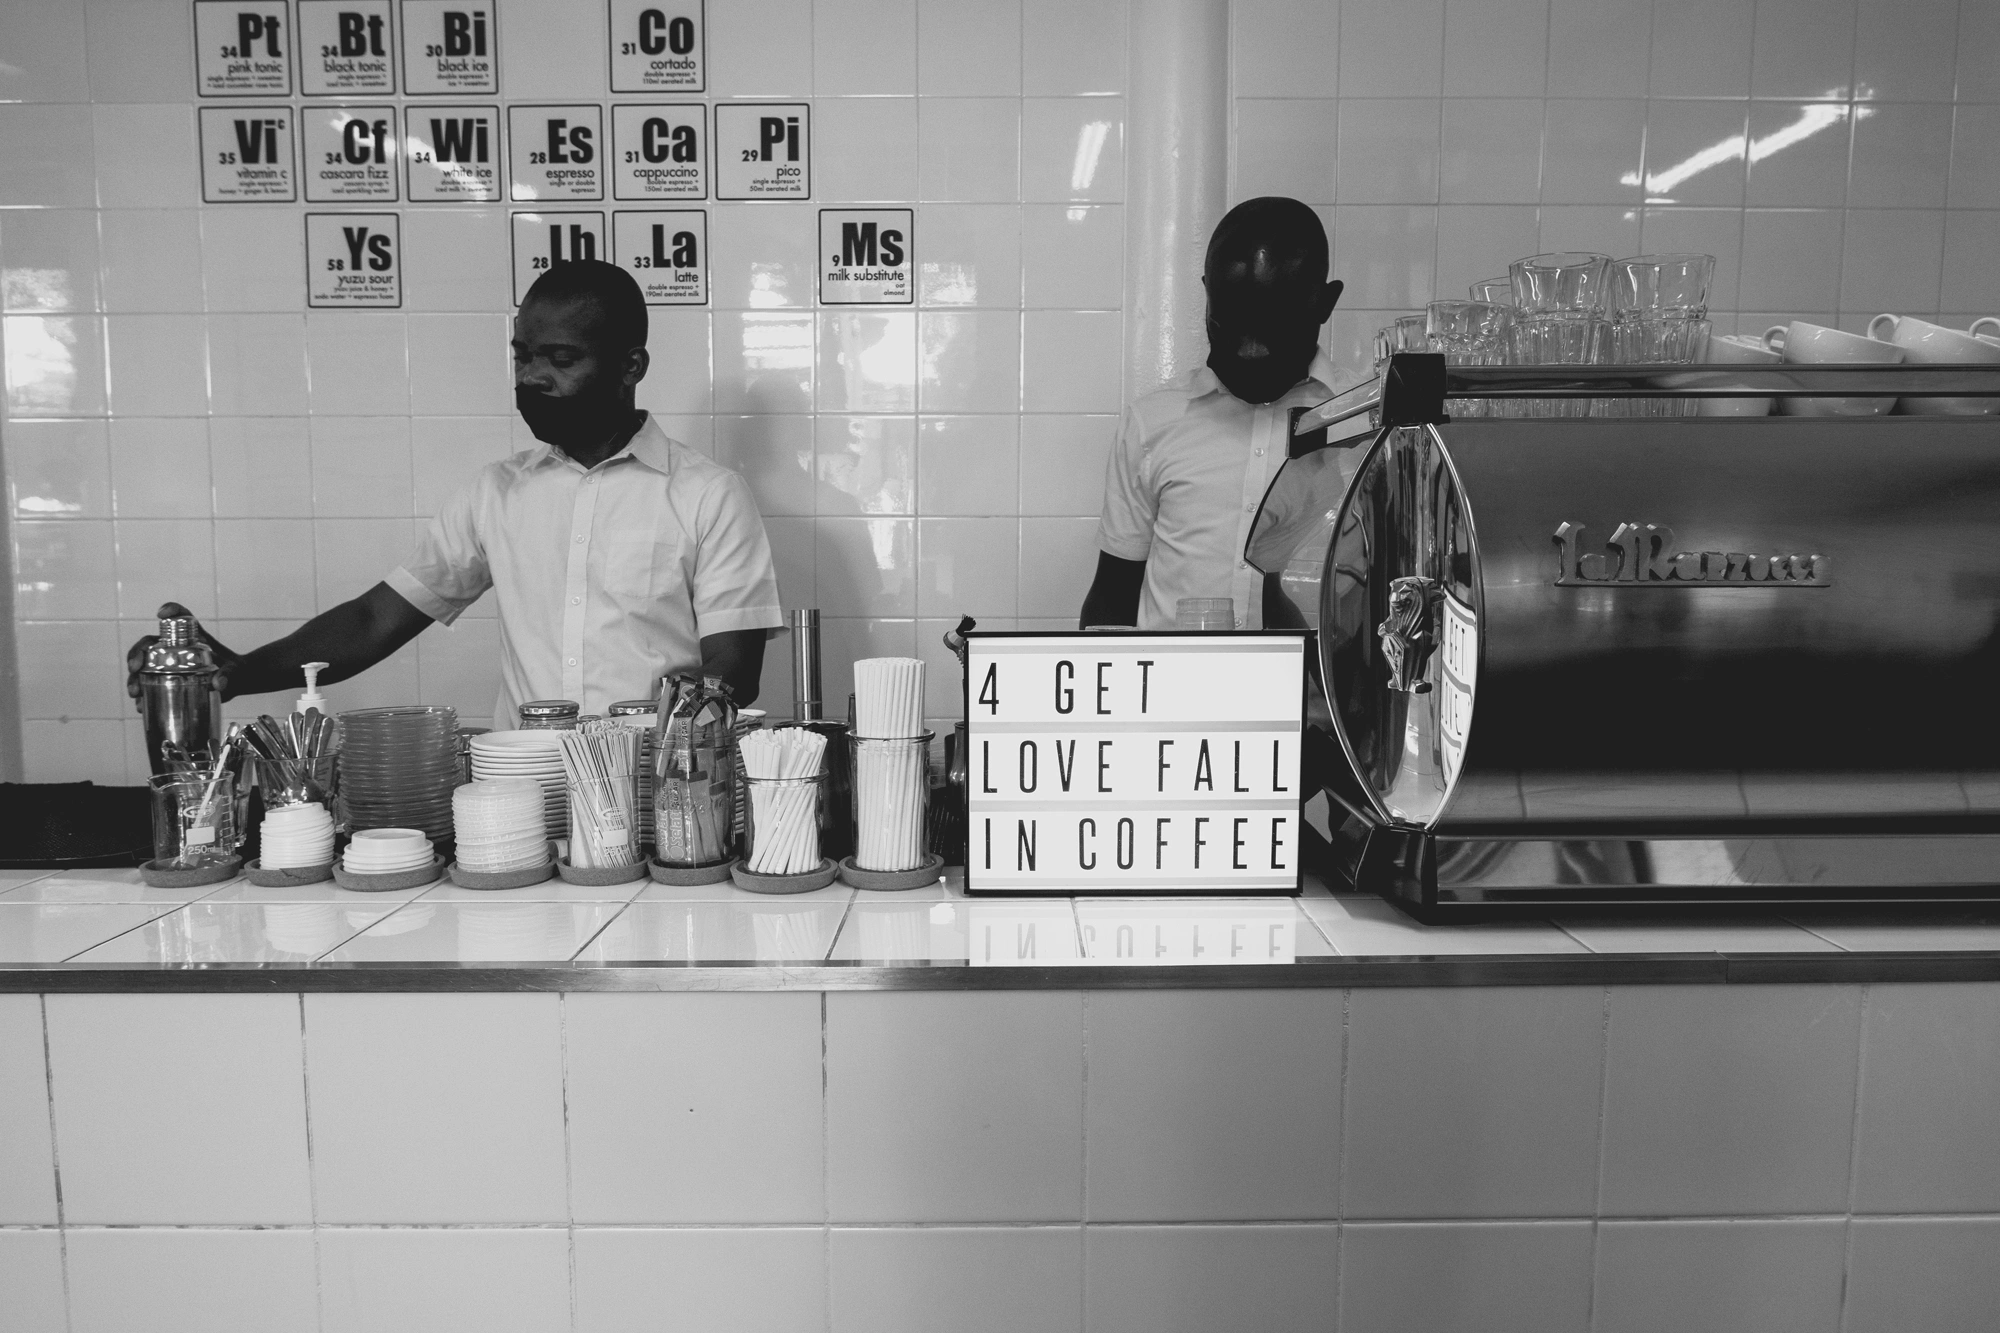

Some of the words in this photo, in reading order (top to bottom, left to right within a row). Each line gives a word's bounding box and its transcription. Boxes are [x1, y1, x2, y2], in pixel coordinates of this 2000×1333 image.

[221, 46, 238, 58] 34
[238, 13, 282, 57] Pt
[321, 45, 338, 57] 34
[339, 12, 386, 57] Bt
[426, 45, 442, 57] 30
[444, 11, 486, 57] Bi
[622, 43, 636, 55] 31
[639, 9, 694, 55] Co
[228, 60, 252, 76] pink
[255, 61, 282, 73] tonic
[324, 59, 356, 72] black
[358, 60, 386, 72] tonic
[437, 58, 469, 72] black
[472, 59, 489, 72] ice
[650, 56, 696, 70] cortado
[219, 152, 235, 165] 35
[326, 152, 342, 165] 34
[344, 119, 387, 165] Cf
[415, 152, 430, 163] 34
[430, 118, 489, 163] Wi
[530, 152, 547, 164] 28
[547, 119, 594, 164] Es
[625, 151, 639, 163] 31
[641, 117, 697, 163] Ca
[742, 149, 758, 162] 29
[760, 117, 799, 162] Pi
[237, 167, 277, 179] vitamin
[320, 170, 365, 179] cascara
[367, 165, 389, 179] fizz
[443, 166, 473, 178] white
[476, 166, 492, 178] ice
[546, 170, 595, 181] espresso
[633, 165, 698, 181] cappuccino
[777, 164, 801, 180] pico
[327, 259, 344, 271] 58
[343, 227, 392, 271] Ys
[532, 257, 549, 269] 28
[550, 224, 595, 263] Lh
[634, 256, 651, 268] 33
[652, 224, 697, 268] La
[832, 255, 840, 266] 9
[842, 222, 904, 267] Ms
[338, 276, 366, 287] yuzu
[369, 275, 394, 284] sour
[675, 269, 699, 282] latte
[828, 268, 850, 280] milk
[854, 268, 904, 280] substitute
[978, 662, 1000, 715] 4
[1055, 660, 1154, 715] GET
[983, 739, 1113, 793] LOVE
[1158, 738, 1288, 793] FALL
[985, 818, 1036, 871] IN
[1078, 817, 1287, 870] COFFEE
